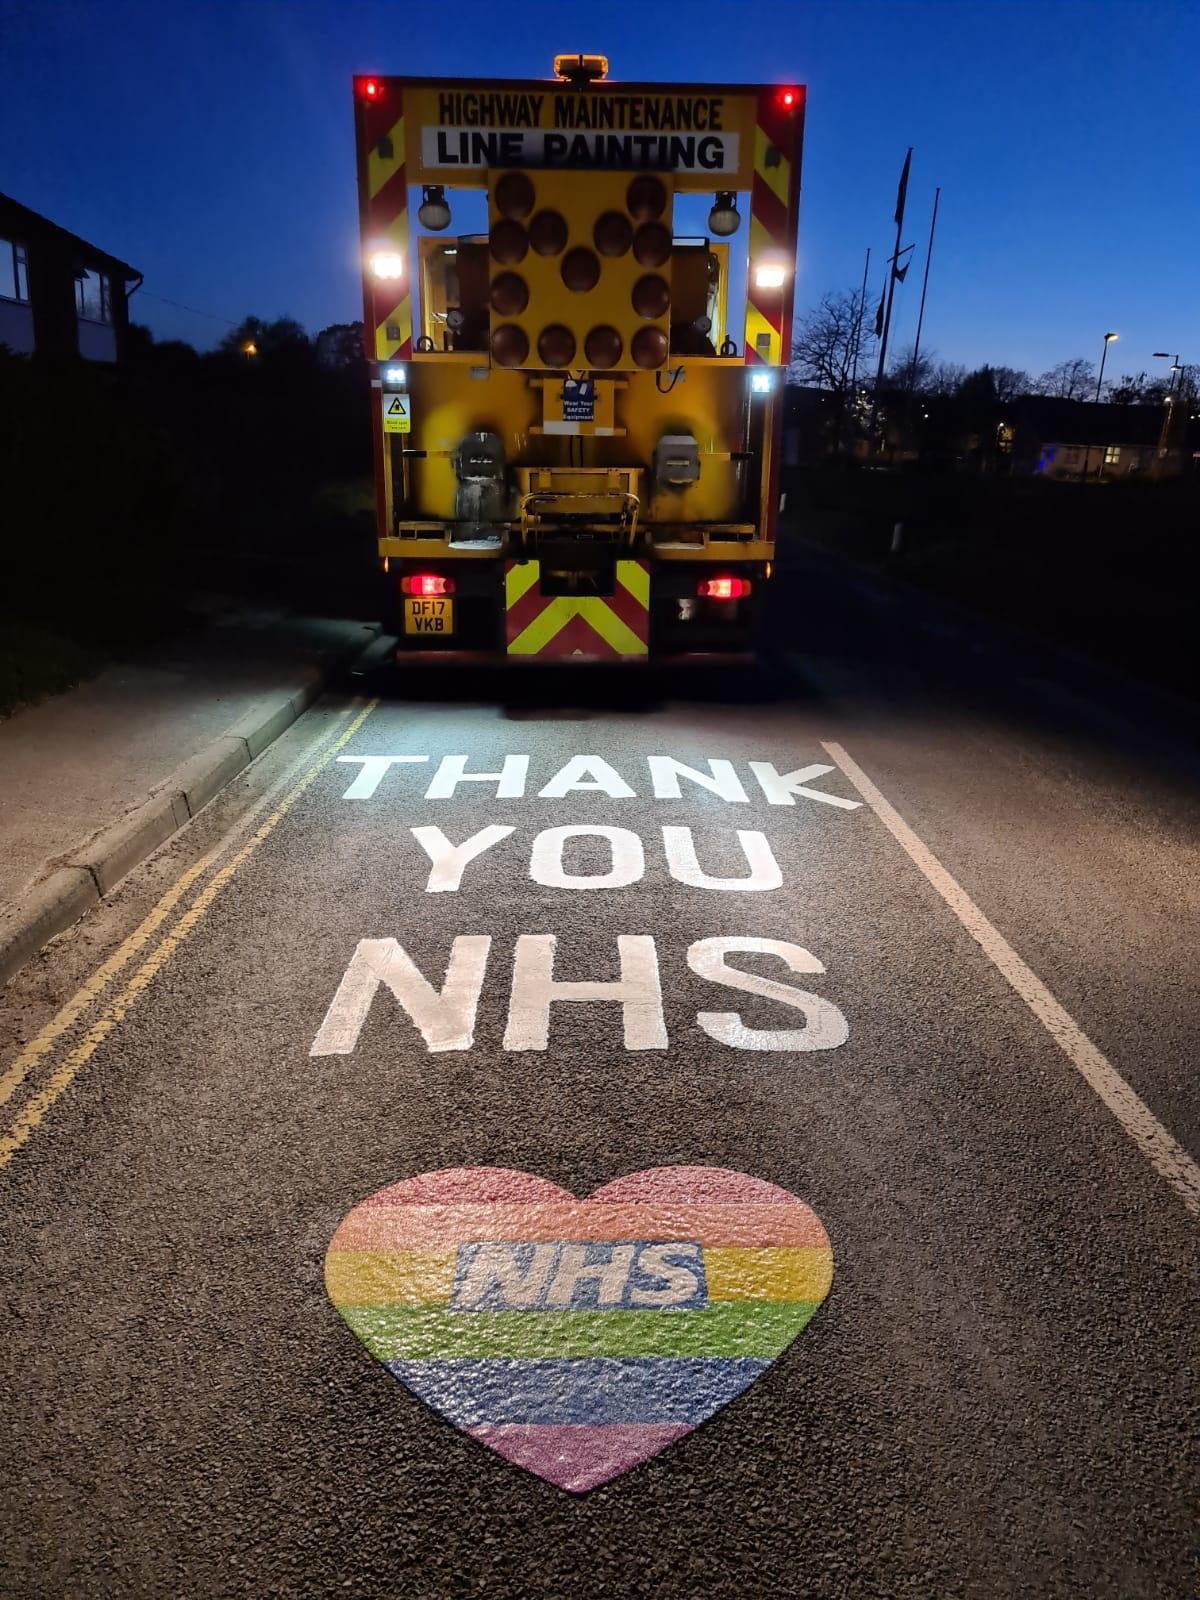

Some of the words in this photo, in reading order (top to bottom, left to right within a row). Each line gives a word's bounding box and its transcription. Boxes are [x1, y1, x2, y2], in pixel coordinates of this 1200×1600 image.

[438, 92, 544, 127] HIGHWAY
[554, 95, 723, 131] MAINTENANCE
[437, 131, 524, 165] LINE
[543, 133, 724, 169] PAINTING
[412, 602, 445, 615] DF17
[414, 617, 444, 631] VKB
[336, 754, 863, 810] THANK
[410, 824, 783, 893] YOU
[308, 934, 849, 1056] NHS
[453, 1243, 699, 1306] NHS
